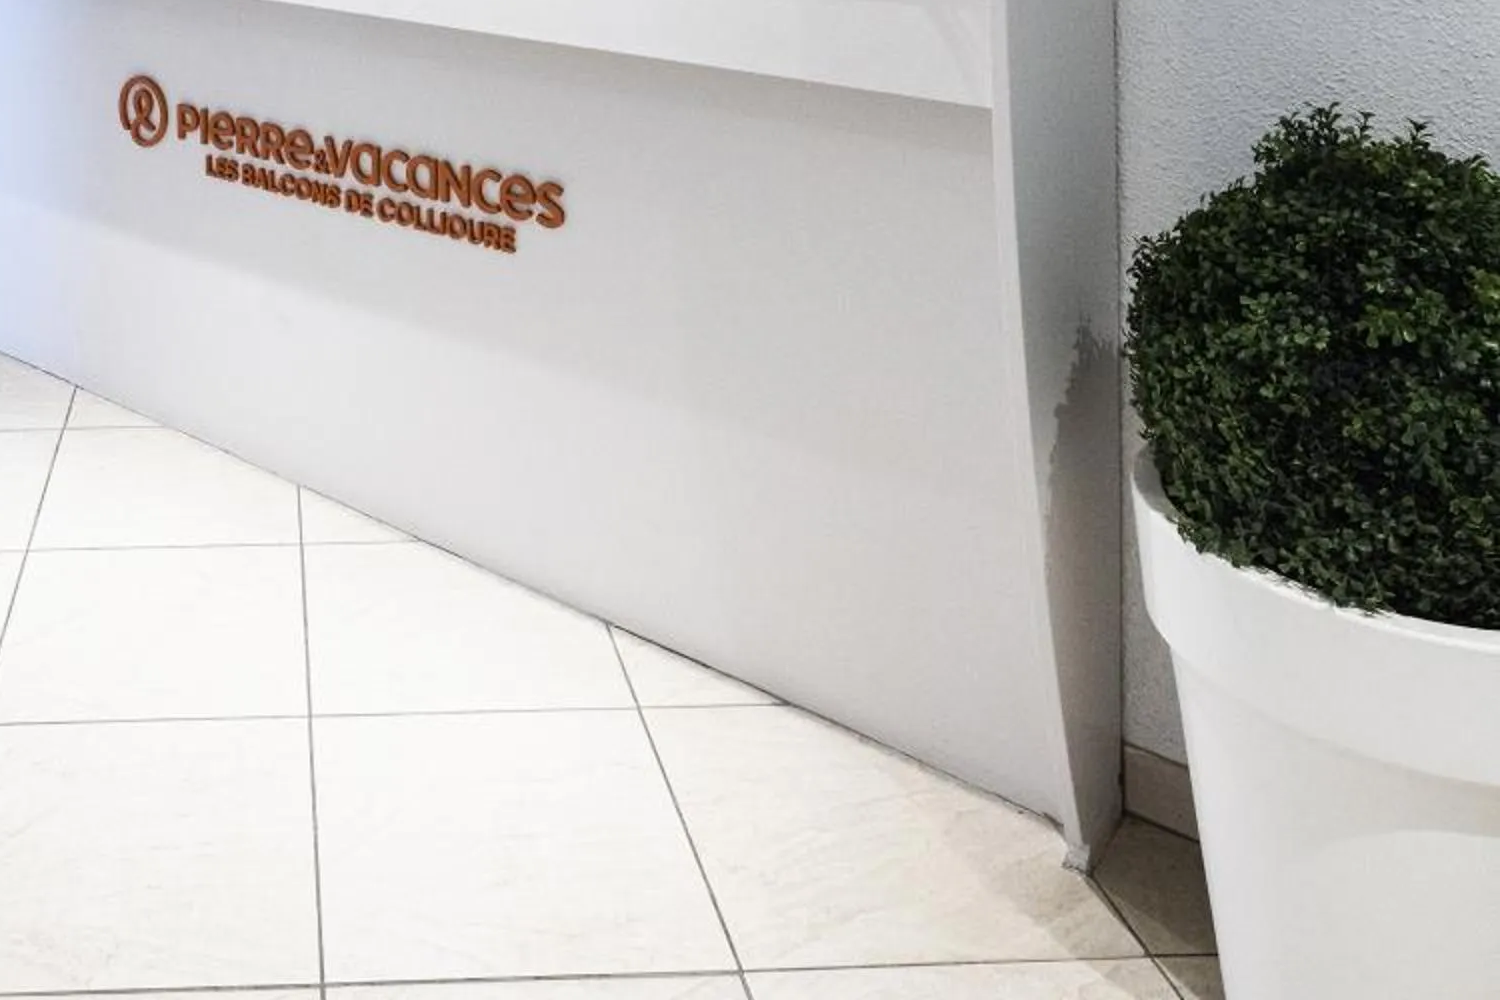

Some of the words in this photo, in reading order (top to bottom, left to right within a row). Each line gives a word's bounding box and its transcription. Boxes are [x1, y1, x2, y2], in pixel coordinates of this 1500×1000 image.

[205, 154, 240, 182] LES
[242, 163, 342, 209] BALCONS
[344, 187, 374, 217] DE
[376, 198, 517, 254] COLLIOURE
